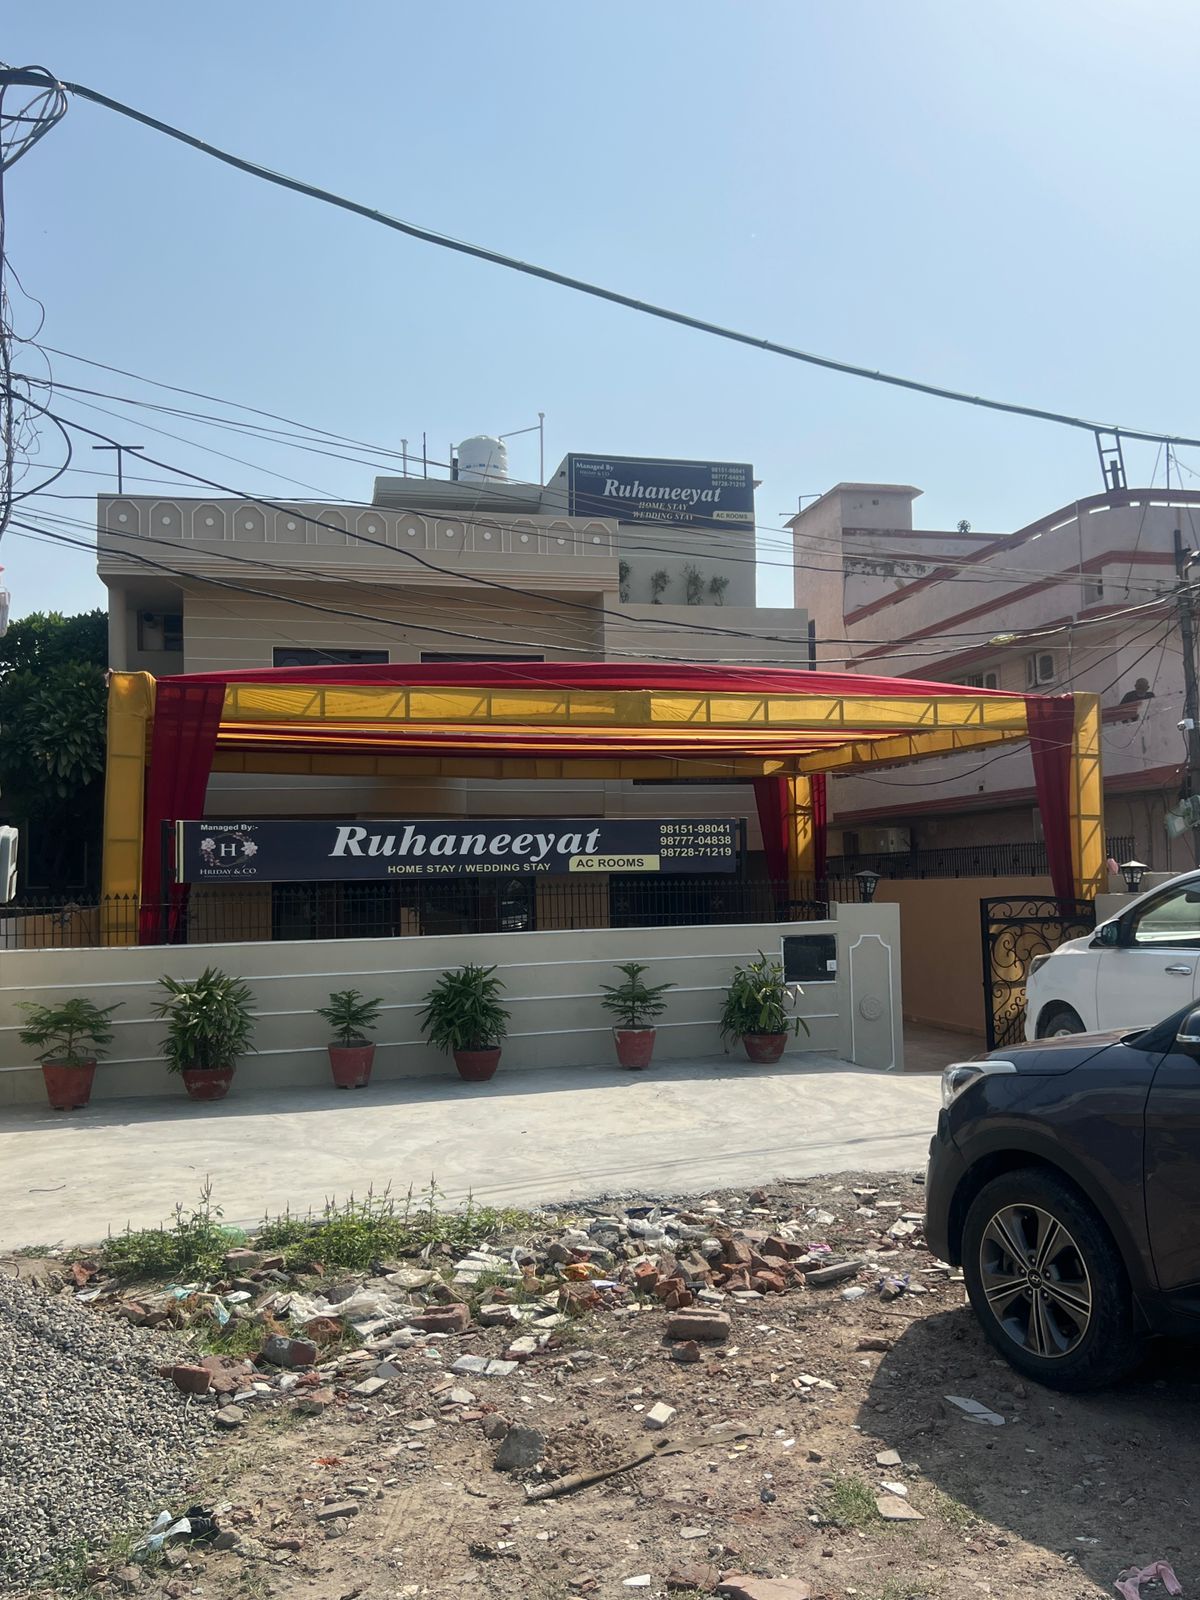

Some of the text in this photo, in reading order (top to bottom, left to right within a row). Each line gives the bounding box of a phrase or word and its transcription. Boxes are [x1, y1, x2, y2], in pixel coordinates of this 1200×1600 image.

[576, 462, 614, 472] Managed By
[603, 478, 721, 505] Ruhaneeyat
[638, 501, 688, 511] HOME STAY
[632, 511, 673, 519] WEDDING
[200, 824, 239, 832] Managed
[660, 824, 730, 834] 98151-98041
[328, 825, 601, 862] Ruhaneeyat
[660, 836, 732, 846] 98777-04838
[220, 843, 237, 857] H
[660, 847, 732, 857] 98728-71219
[576, 858, 645, 868] AC ROOMS
[233, 867, 241, 875] &
[387, 865, 424, 874] HOME
[426, 864, 457, 873] STAY
[465, 863, 521, 872] WEDDING
[523, 863, 551, 871] STAY
